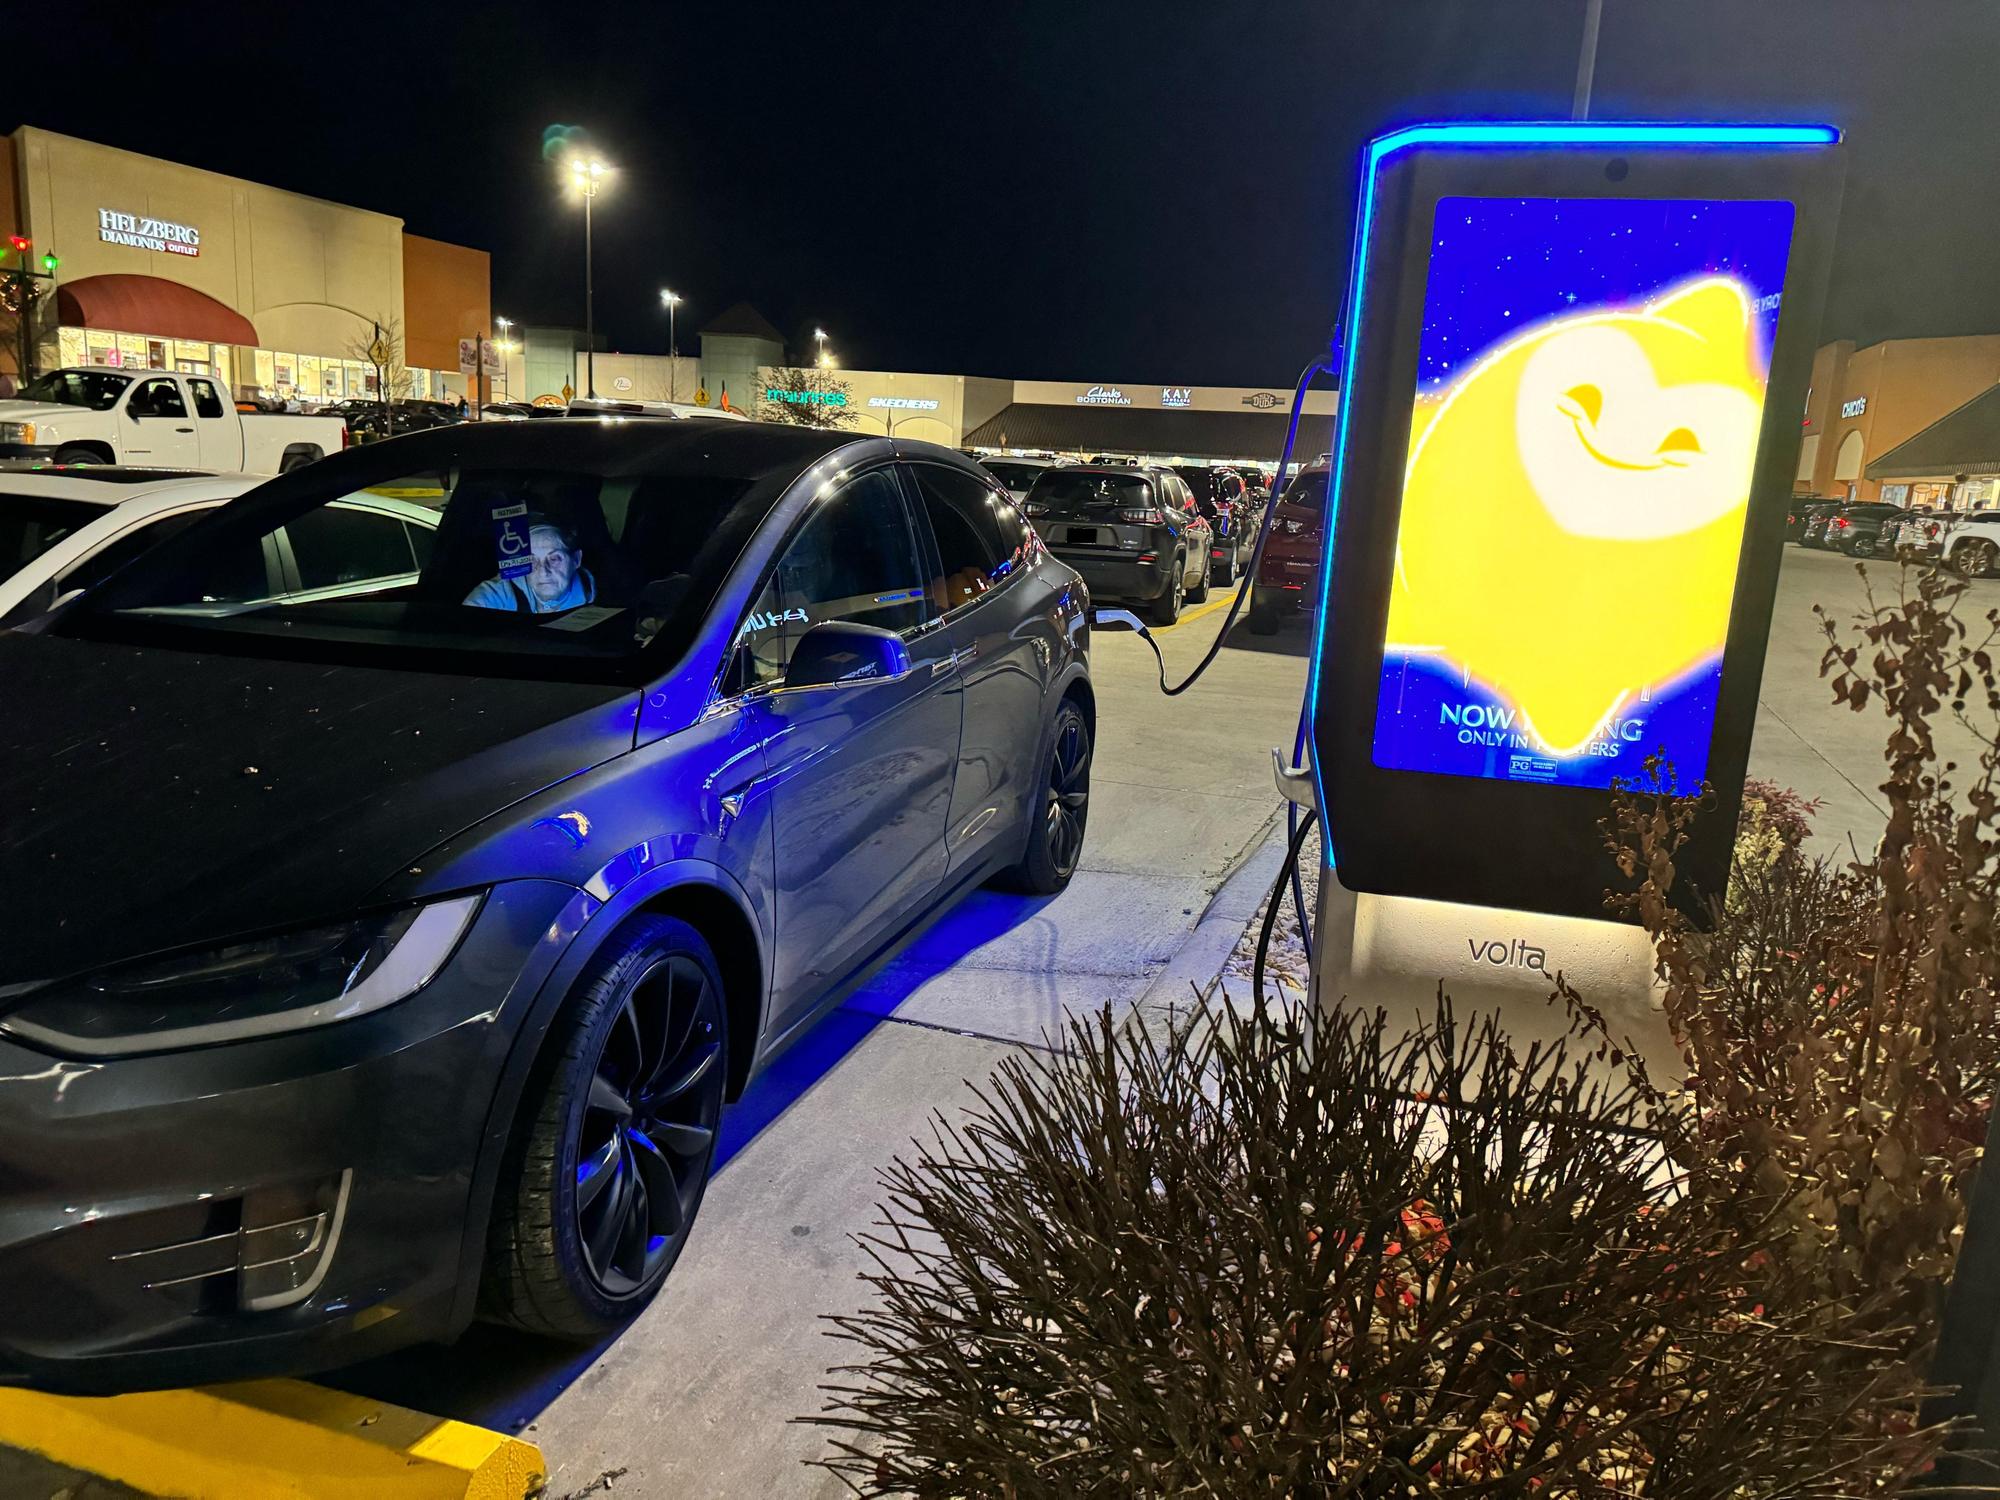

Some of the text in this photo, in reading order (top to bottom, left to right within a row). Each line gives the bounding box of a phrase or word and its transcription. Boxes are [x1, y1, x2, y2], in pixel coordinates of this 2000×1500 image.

[98, 208, 199, 245] HELZBERG
[101, 229, 198, 256] DIAMONDS OUTLET
[1087, 386, 1121, 398] Clarks
[1163, 388, 1191, 399] KAY
[867, 397, 938, 409] SKECHERS
[1076, 396, 1131, 405] BOSTONIAN
[1253, 396, 1274, 408] DUDE
[1440, 702, 1516, 730] NOW
[1458, 729, 1507, 747] ONLY
[1510, 733, 1529, 749] IN
[1511, 760, 1530, 771] PG
[1468, 938, 1546, 971] volta
